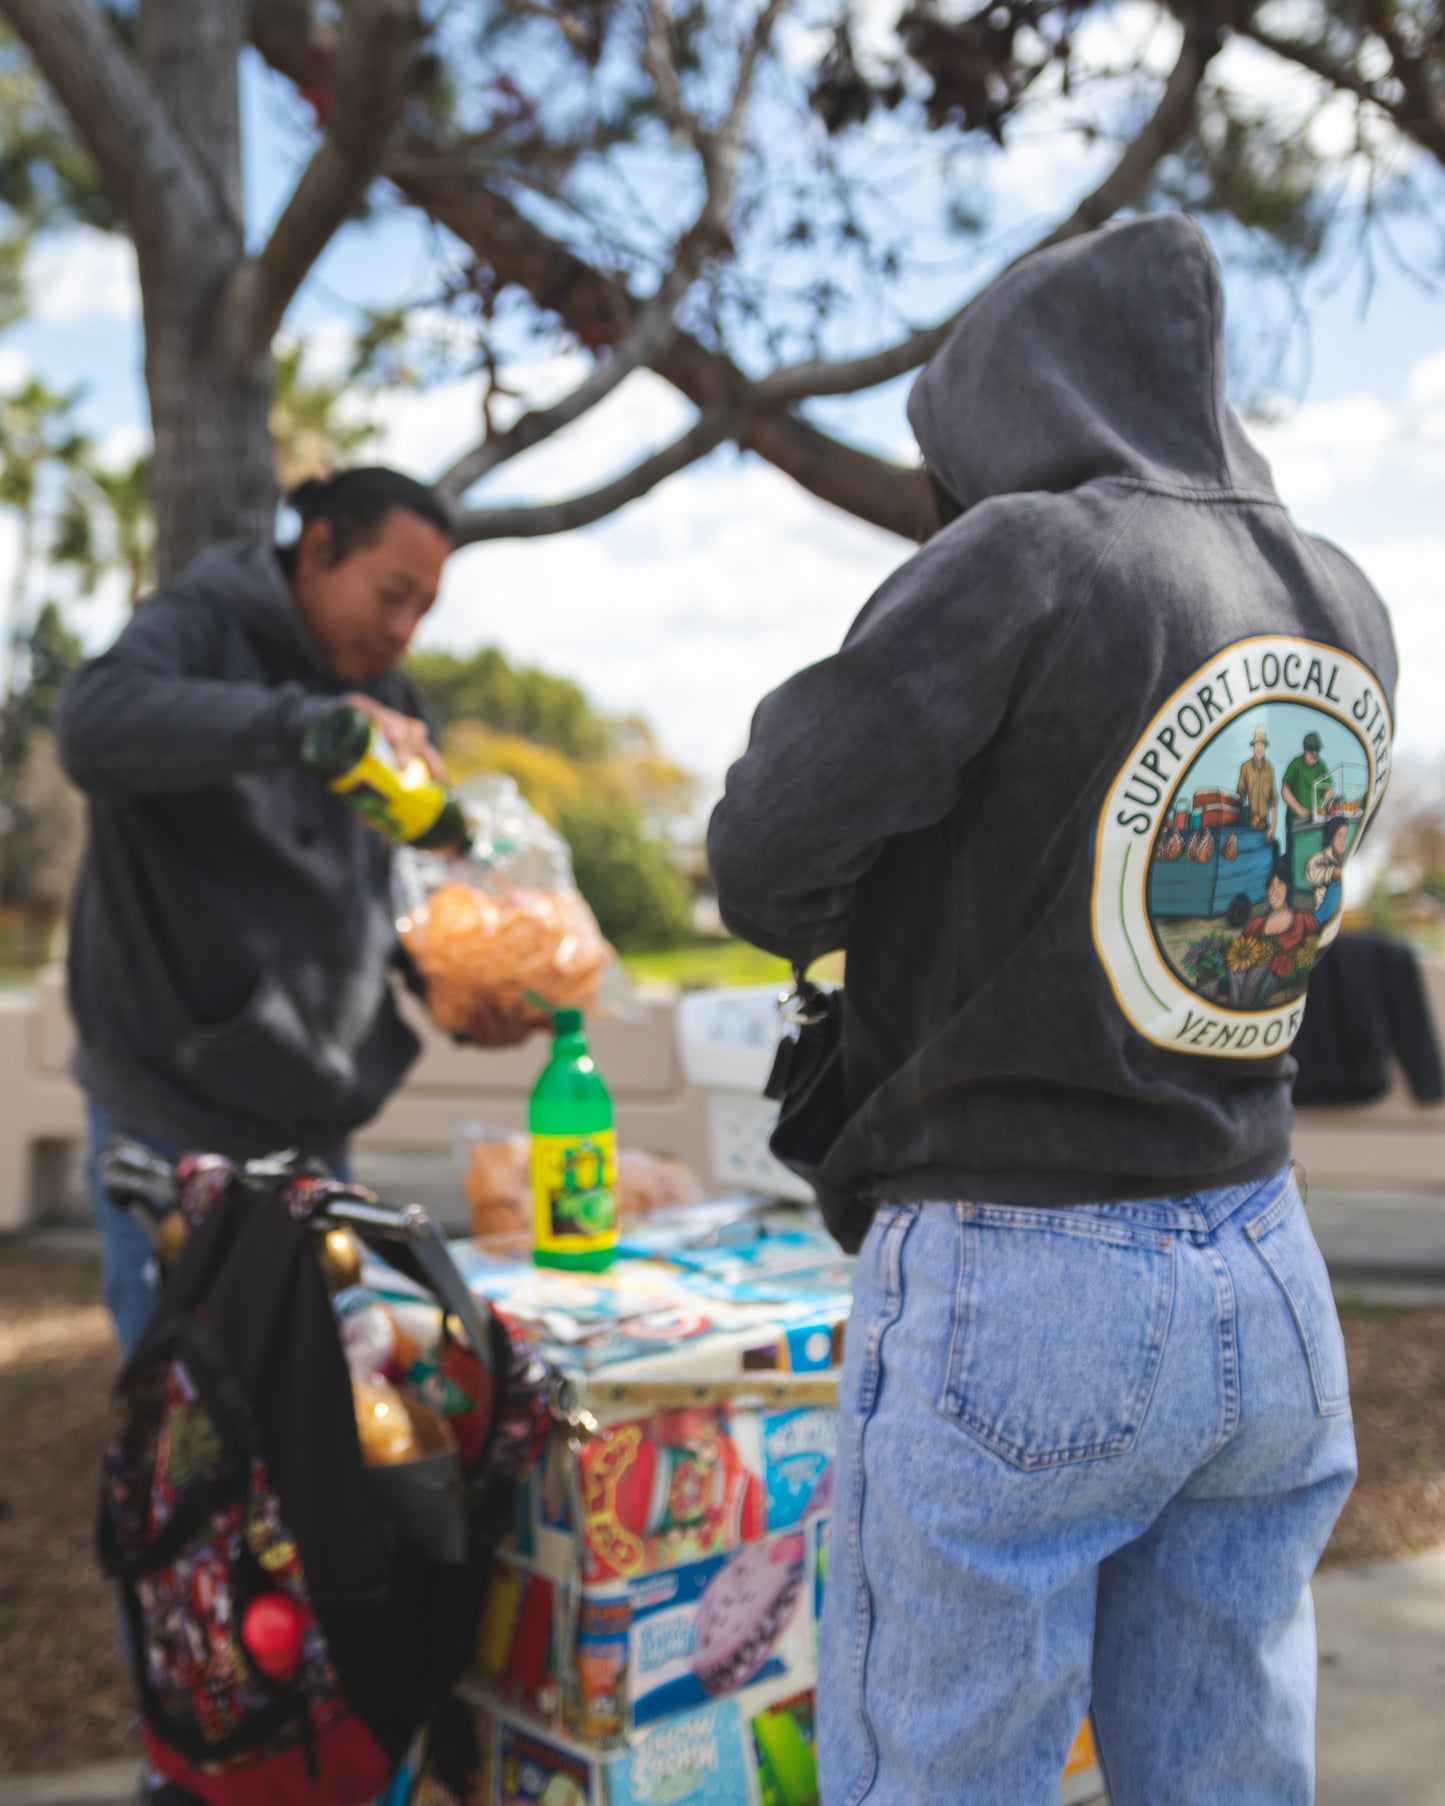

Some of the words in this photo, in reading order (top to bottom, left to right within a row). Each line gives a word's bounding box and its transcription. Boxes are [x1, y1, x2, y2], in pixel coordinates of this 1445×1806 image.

[1116, 669, 1235, 835] SUPPORT
[1243, 653, 1341, 703] LOCAL
[1352, 687, 1389, 796] STREE
